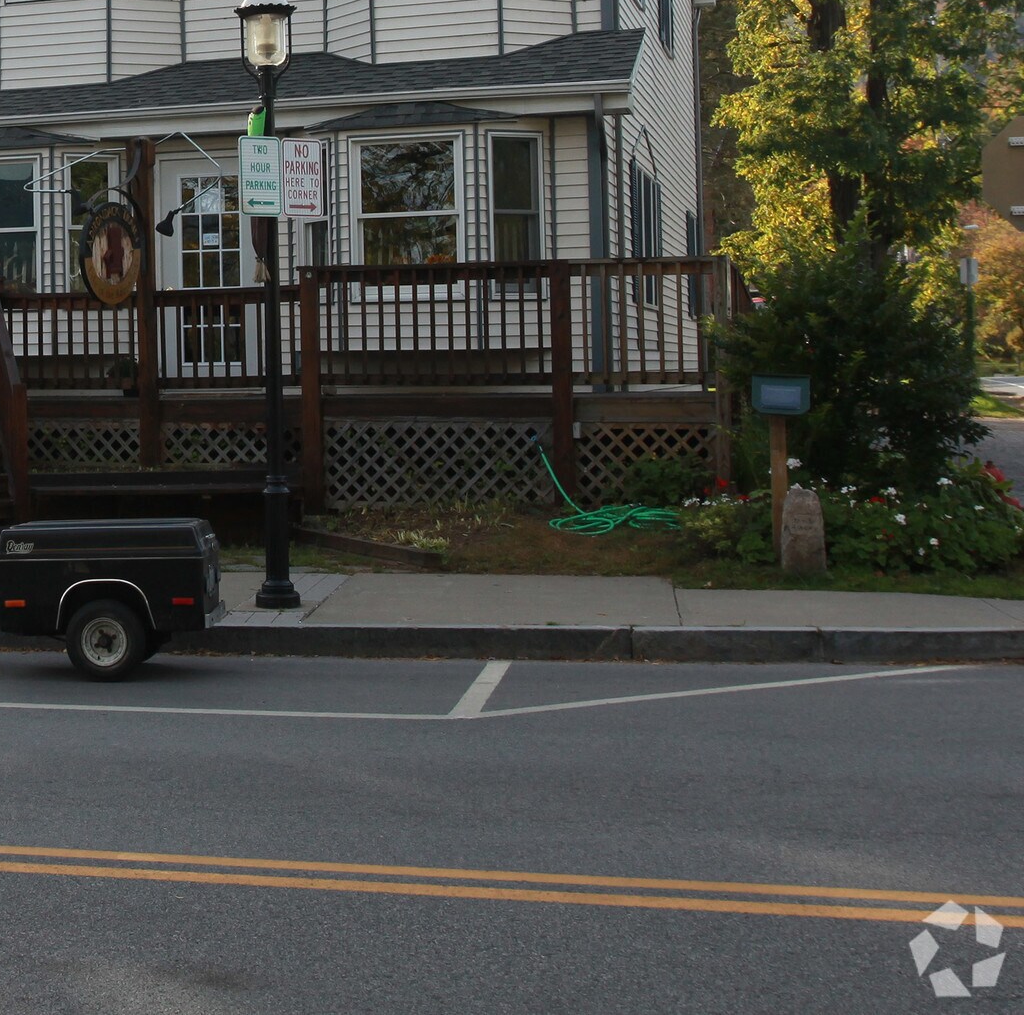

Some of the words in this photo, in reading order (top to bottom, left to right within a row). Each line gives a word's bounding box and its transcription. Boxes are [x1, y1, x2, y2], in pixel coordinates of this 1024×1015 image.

[252, 145, 268, 155] TWO
[294, 144, 309, 159] NO
[250, 162, 271, 173] HOUR
[285, 160, 319, 176] PARKING
[245, 180, 277, 191] PARKING
[285, 177, 305, 188] HERE
[310, 178, 320, 188] TO
[288, 189, 318, 200] CORNER
